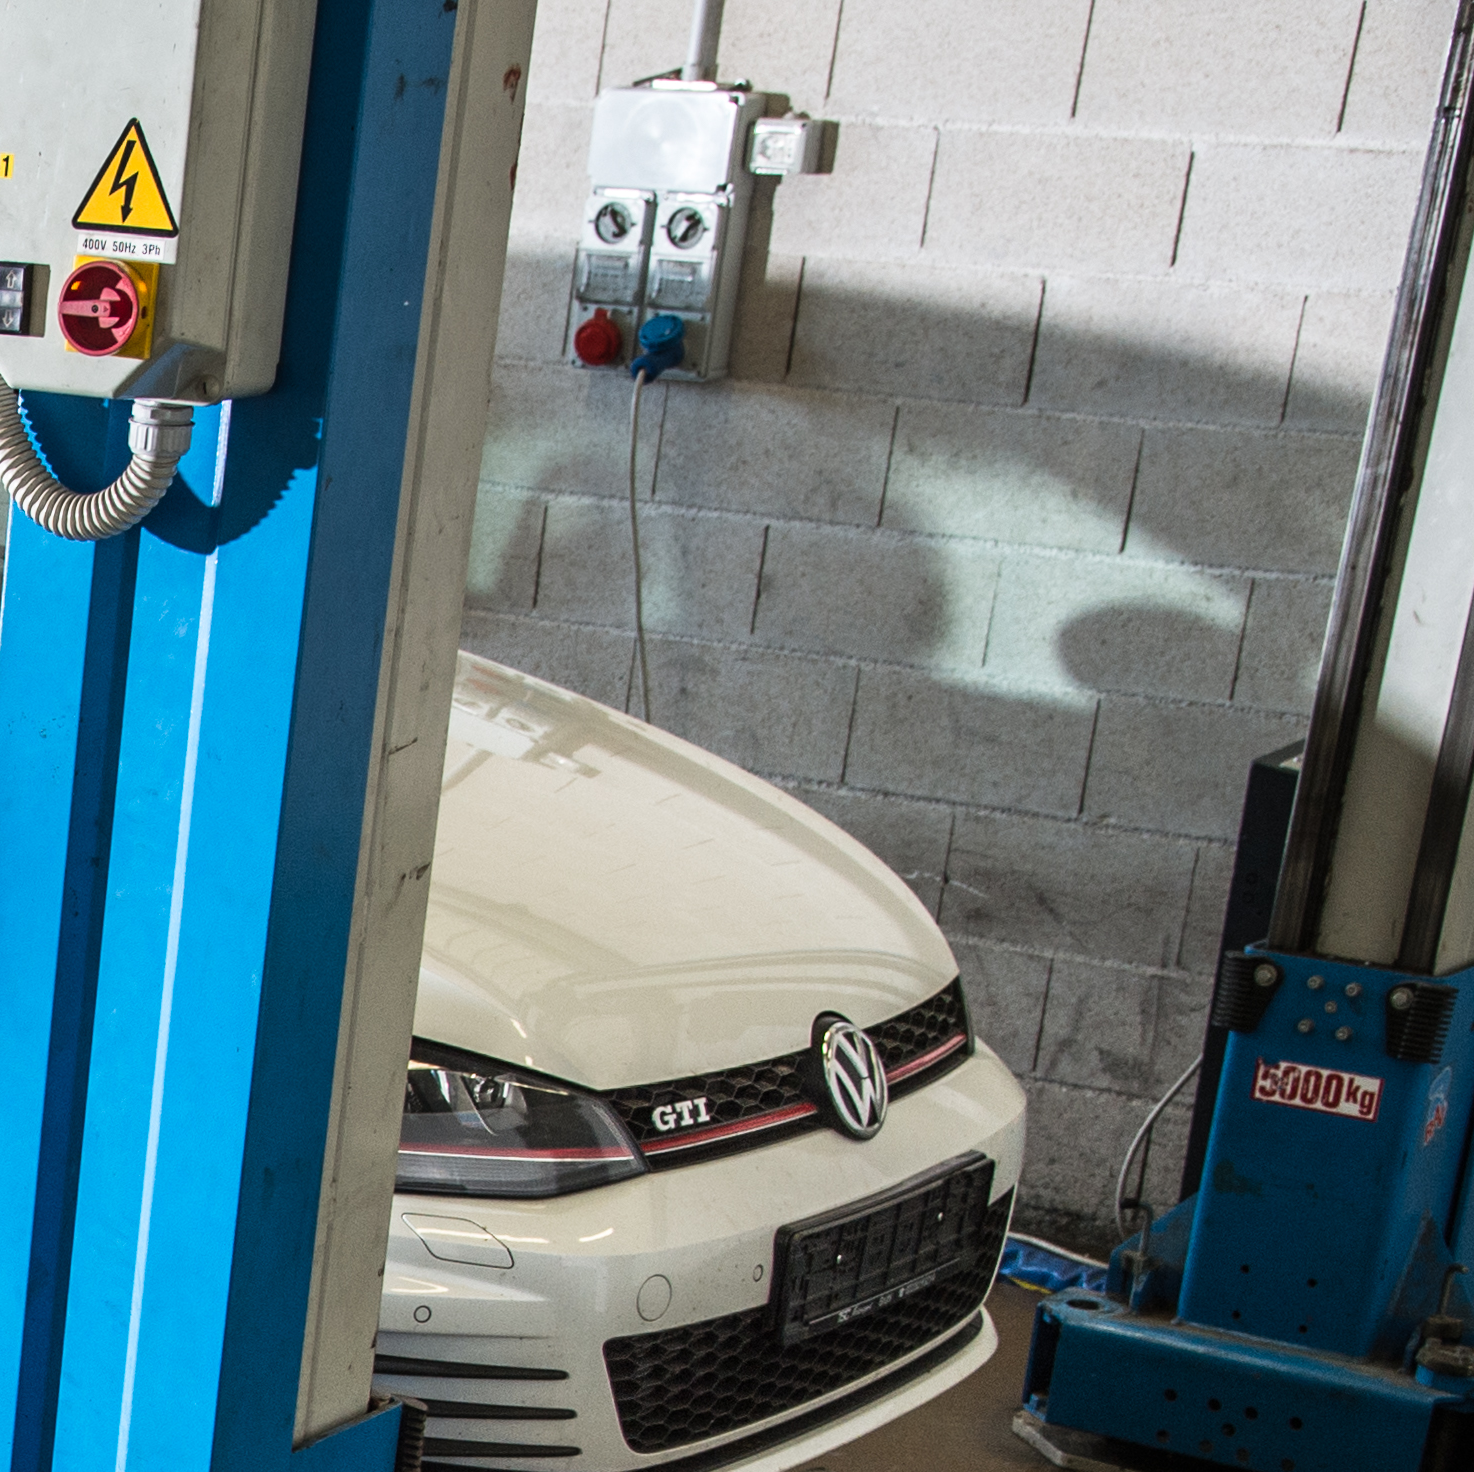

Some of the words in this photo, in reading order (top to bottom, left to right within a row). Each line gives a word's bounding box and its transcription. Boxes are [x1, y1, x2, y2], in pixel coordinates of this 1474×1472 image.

[2, 155, 10, 177] 1
[82, 238, 107, 251] 400V
[112, 240, 137, 254] 50Hz
[141, 243, 161, 256] 3Ph
[651, 1097, 711, 1133] GTI
